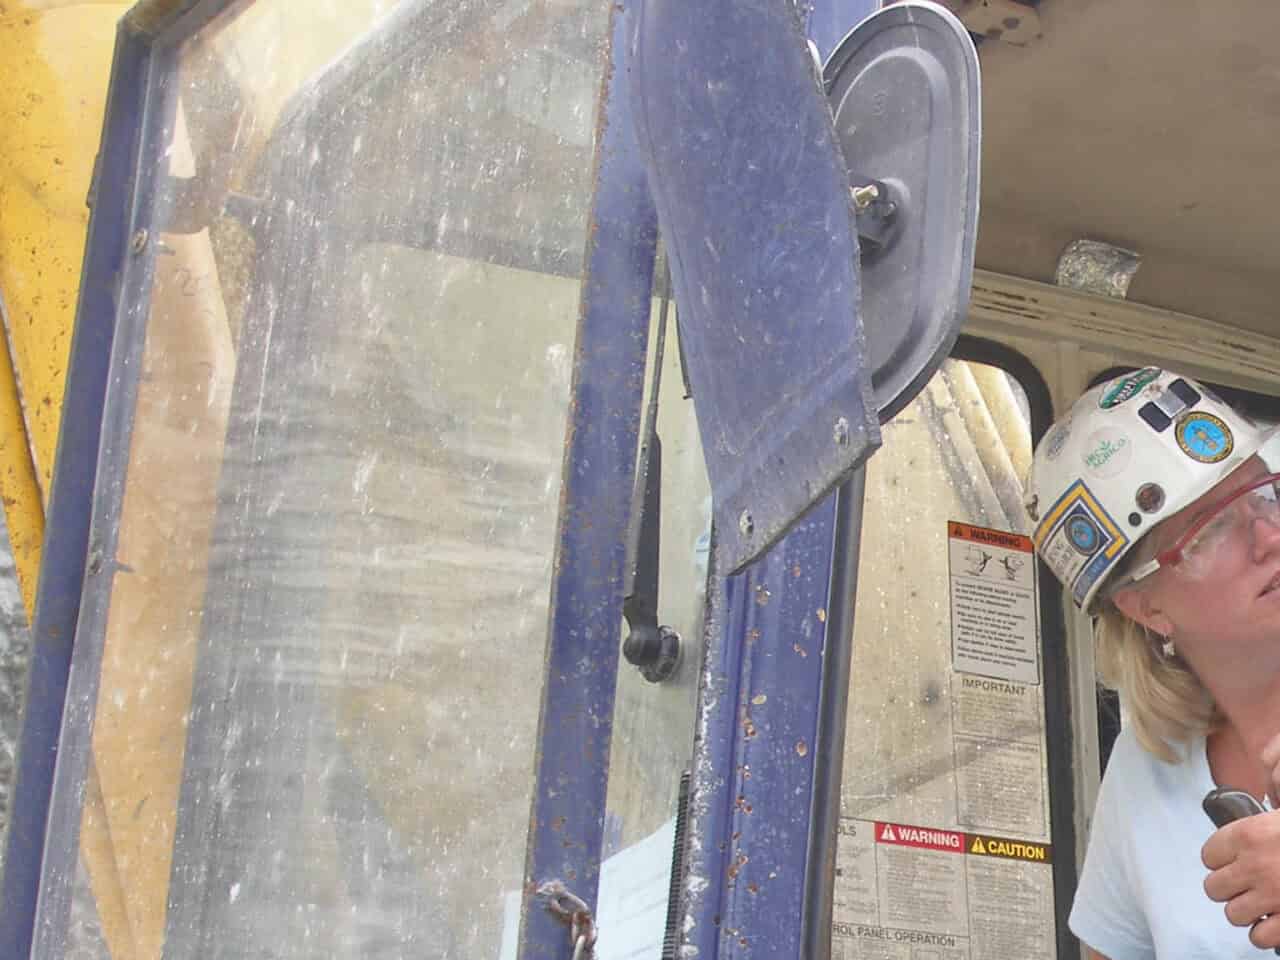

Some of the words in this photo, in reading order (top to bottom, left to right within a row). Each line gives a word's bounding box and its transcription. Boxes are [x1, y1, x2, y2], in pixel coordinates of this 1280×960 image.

[961, 678, 1027, 696] IMPORTANT
[898, 827, 960, 848] WARNING
[988, 839, 1045, 860] CAUTION
[857, 926, 893, 940] PANEL
[894, 930, 956, 947] OPERATION
